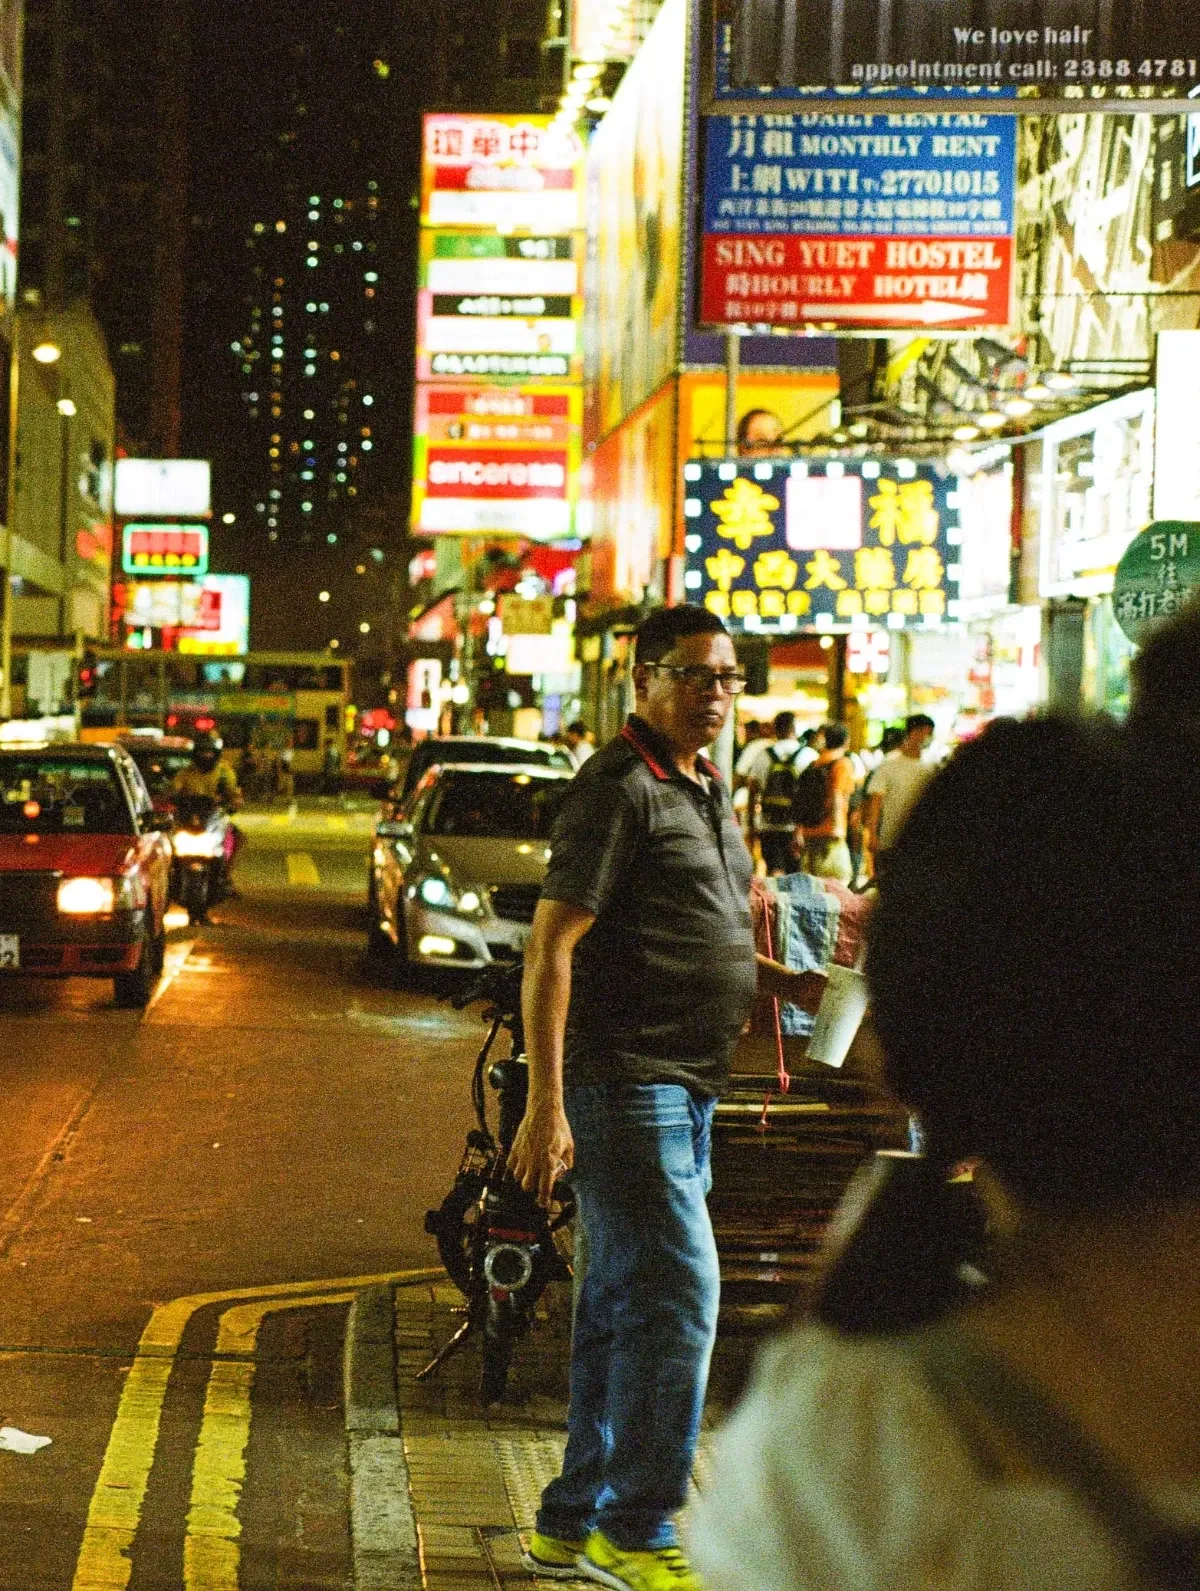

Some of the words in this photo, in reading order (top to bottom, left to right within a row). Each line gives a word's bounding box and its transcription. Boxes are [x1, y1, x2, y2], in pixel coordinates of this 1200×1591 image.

[953, 26, 984, 44] We
[990, 26, 1038, 44] love
[1043, 25, 1093, 44] hair
[851, 59, 1003, 81] appointment
[1008, 59, 1058, 79] call:
[1063, 59, 1131, 79] 2388
[1137, 59, 1198, 79] 4781
[801, 135, 923, 157] MONTHLY
[932, 135, 1001, 157] RENT
[880, 169, 1001, 196] 27701015
[715, 239, 785, 267] SING
[800, 240, 875, 268] YUET
[886, 241, 1003, 269] HOSTEL
[1150, 533, 1189, 561] 5M
